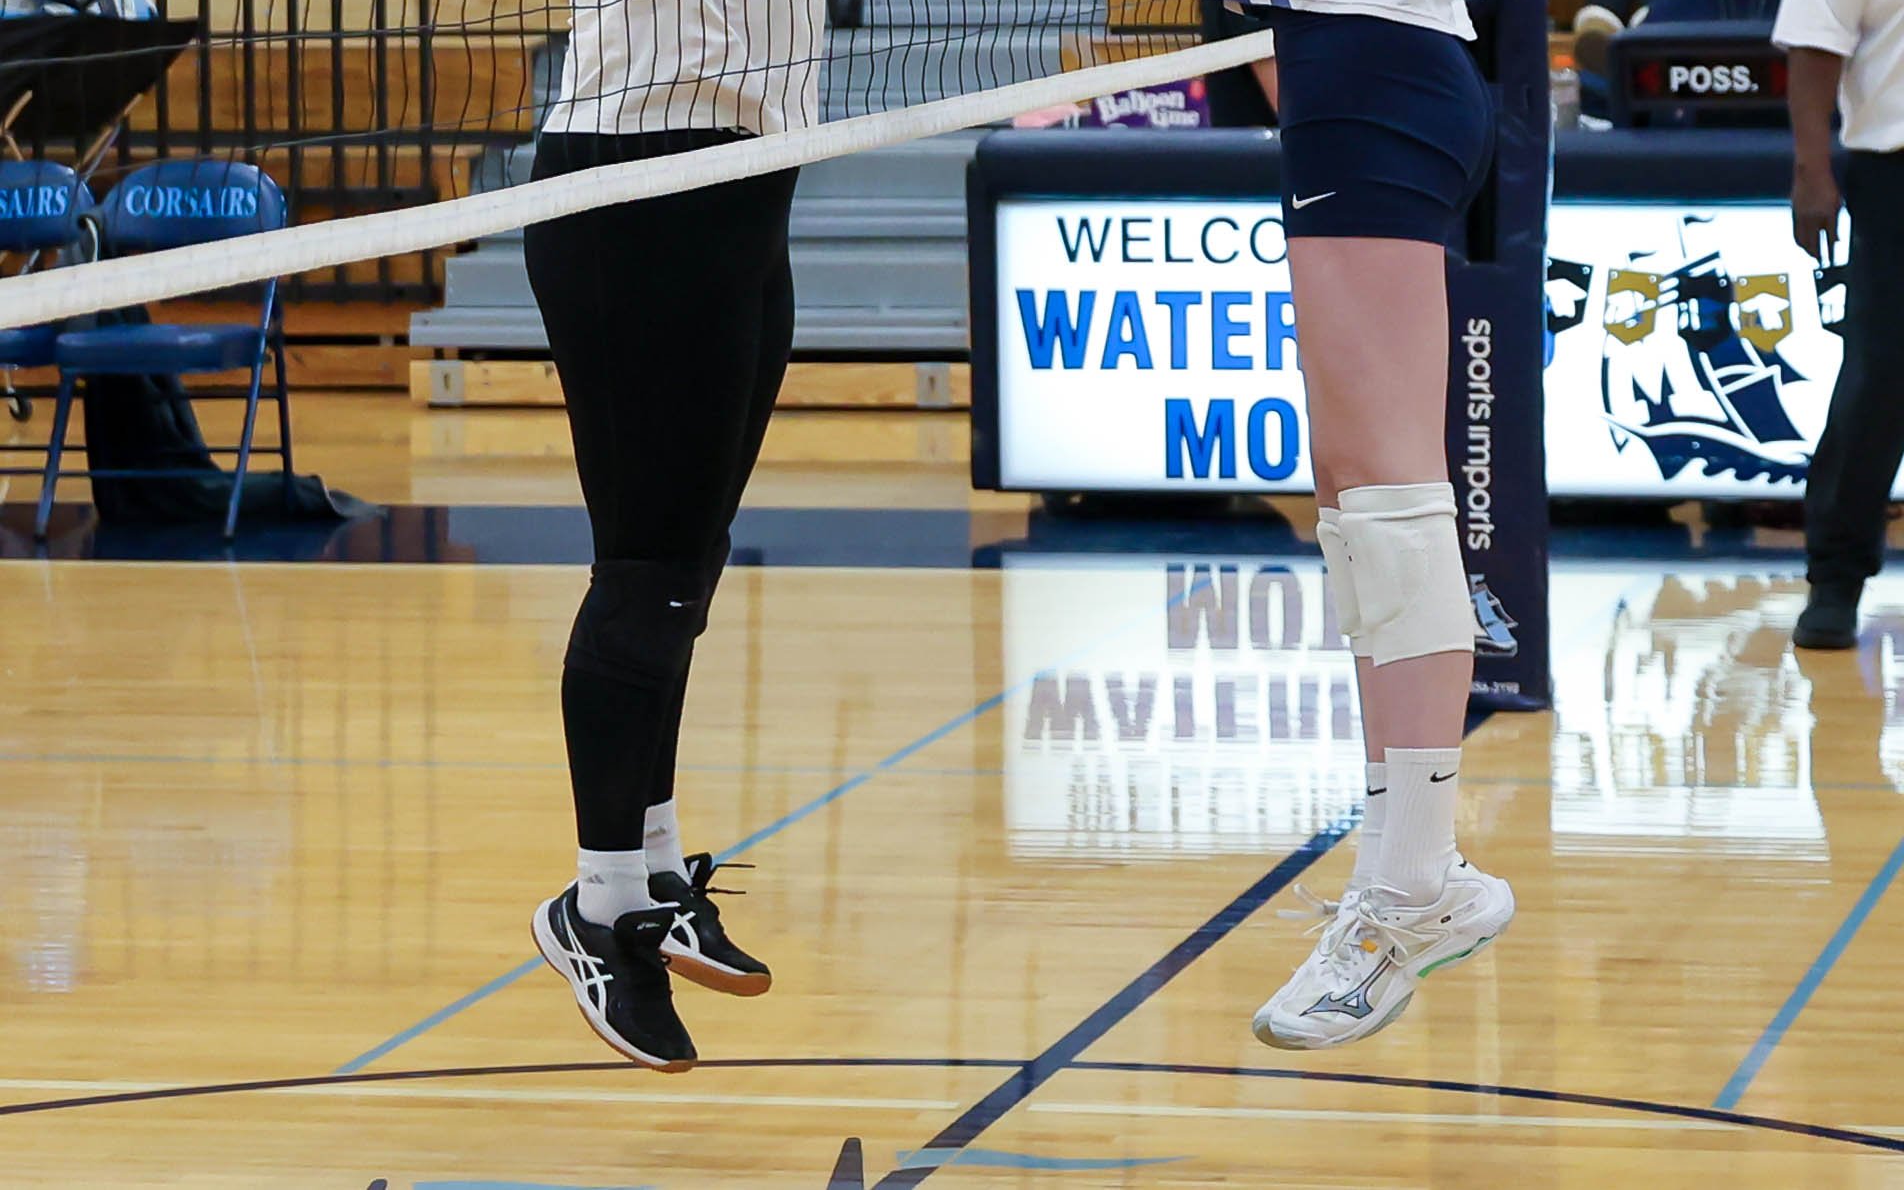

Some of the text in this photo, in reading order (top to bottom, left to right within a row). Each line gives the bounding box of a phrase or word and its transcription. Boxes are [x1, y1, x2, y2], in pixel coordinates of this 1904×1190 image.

[1669, 65, 1760, 93] POSS.
[124, 185, 258, 218] CORSAIRS
[1056, 216, 1288, 264] WELCO
[1015, 287, 1300, 371] WATER
[1164, 396, 1301, 482] MO
[1461, 317, 1496, 552] sports imports
